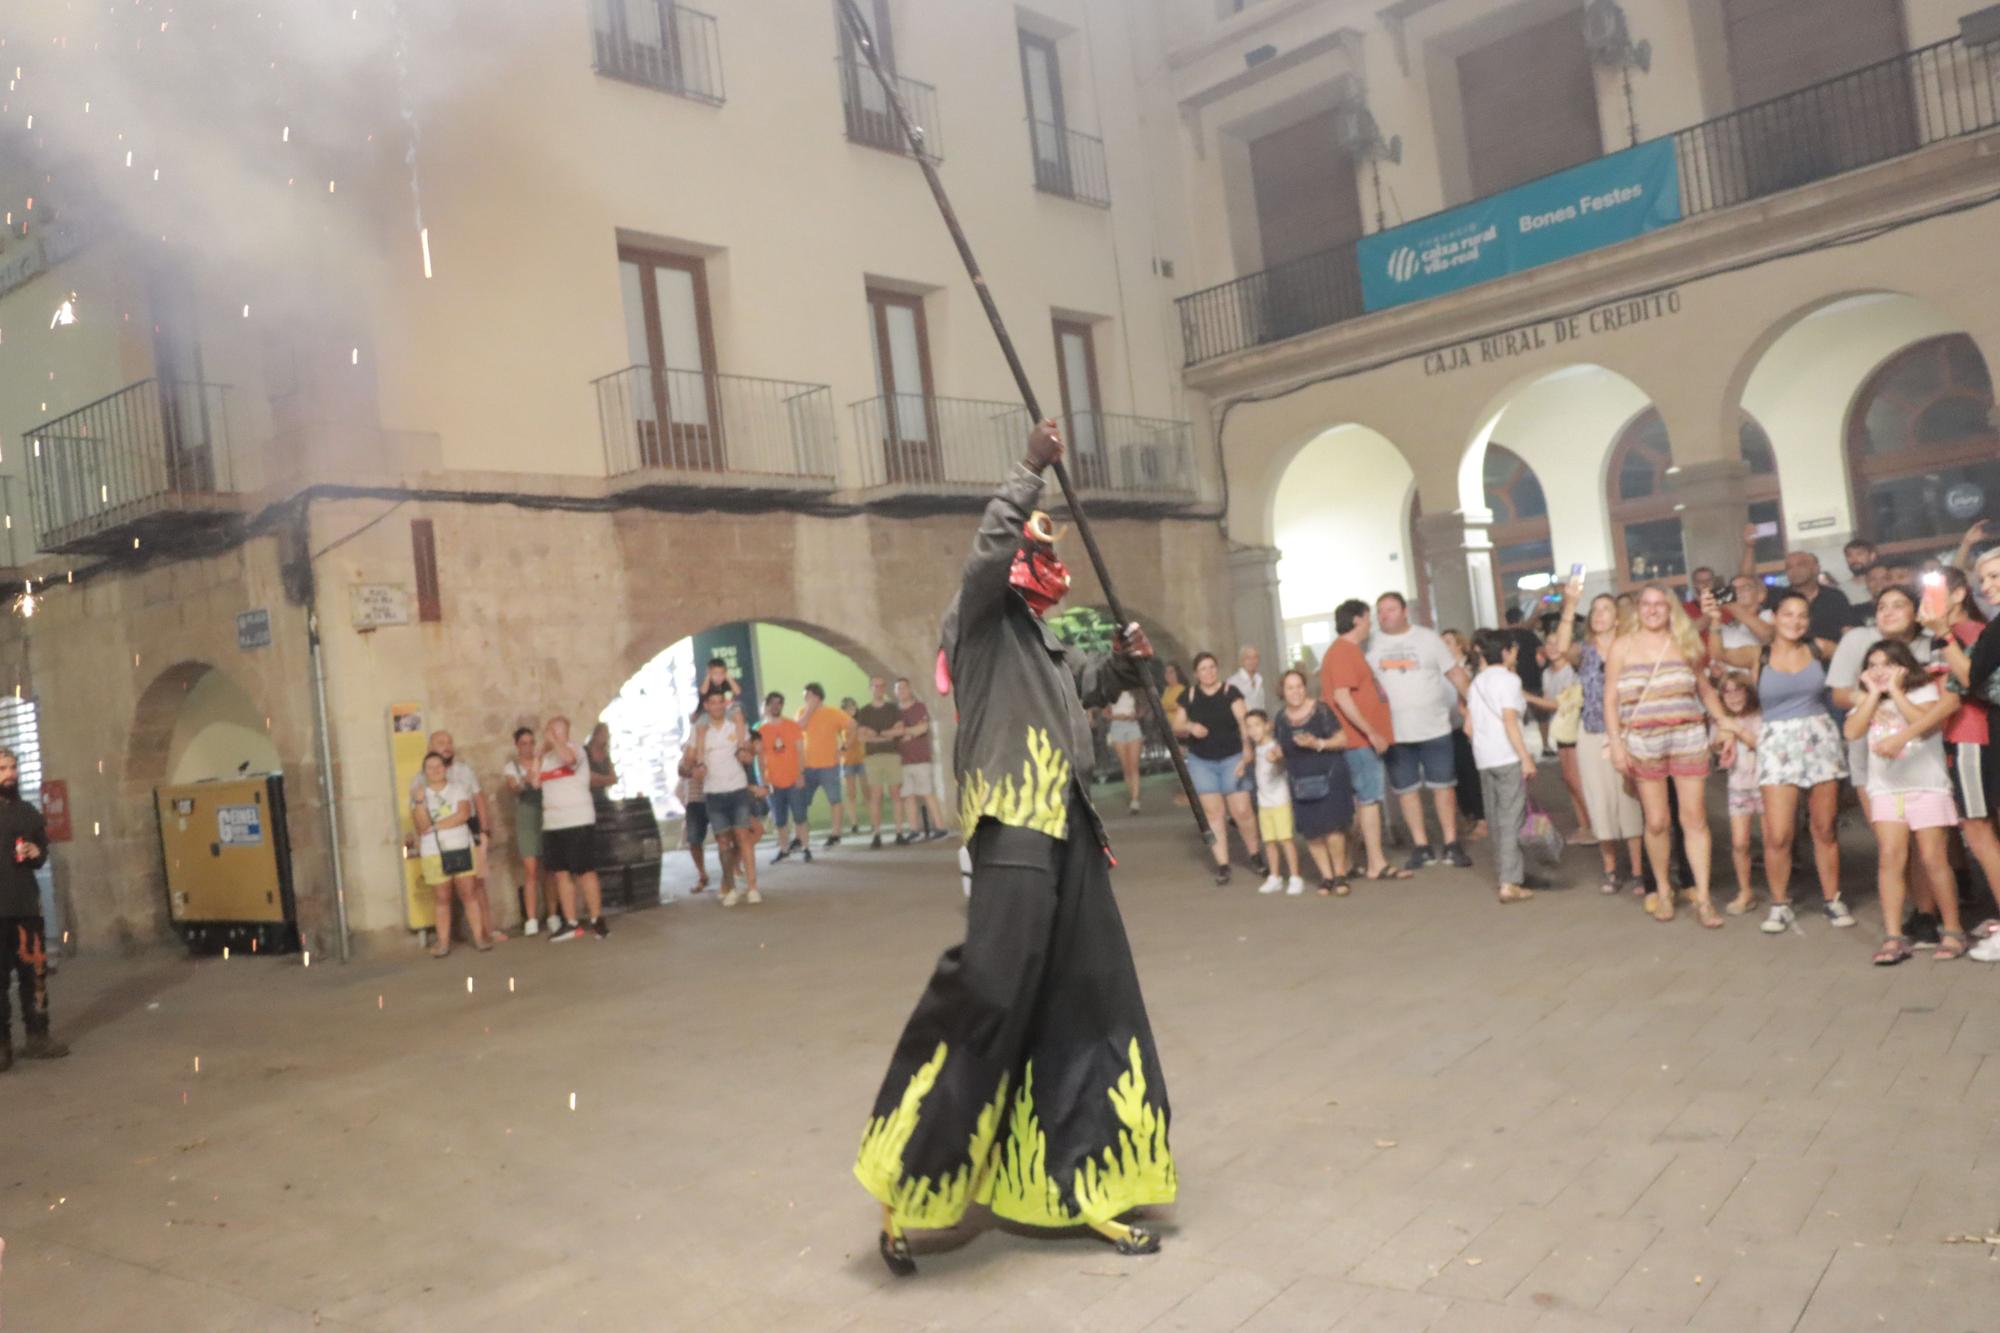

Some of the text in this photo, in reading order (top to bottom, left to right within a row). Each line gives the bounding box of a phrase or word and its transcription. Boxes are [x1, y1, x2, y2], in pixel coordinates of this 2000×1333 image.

[1519, 184, 1643, 233] Bones Festes
[1422, 241, 1458, 262] caixa
[1461, 224, 1496, 249] rural
[1424, 290, 1681, 376] CAJA RURAL DE CREDITO
